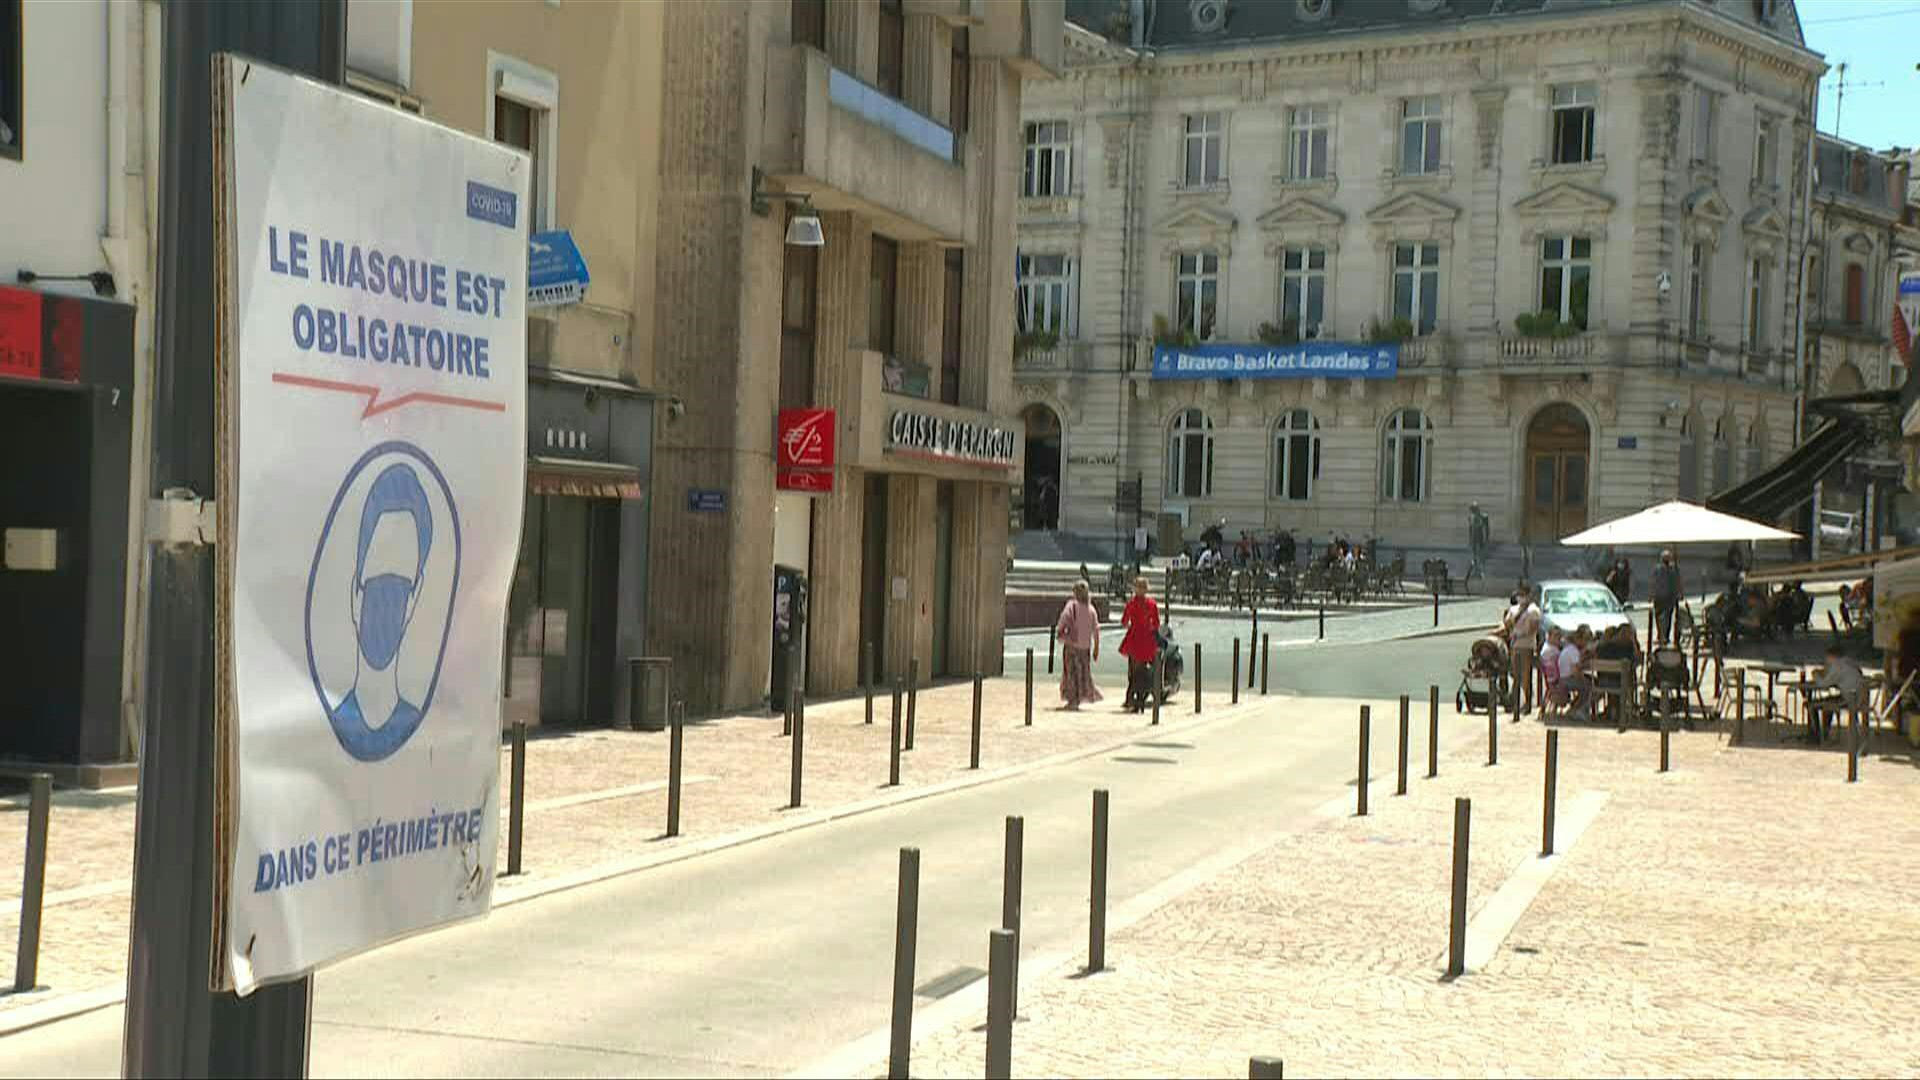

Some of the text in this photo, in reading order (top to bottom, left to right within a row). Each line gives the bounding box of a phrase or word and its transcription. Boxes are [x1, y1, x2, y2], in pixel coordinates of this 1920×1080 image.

[472, 193, 512, 216] COVID-19
[269, 226, 505, 318] LE MASQUE EST
[293, 304, 490, 378] OBLIGATOIRE
[1177, 353, 1229, 371] Bravo
[1234, 351, 1296, 370] Basket
[1300, 351, 1370, 370] Landes
[111, 387, 121, 406] 7
[892, 411, 943, 451] CAISSE
[254, 807, 482, 893] DANS CE PÉRIMÈTRE
